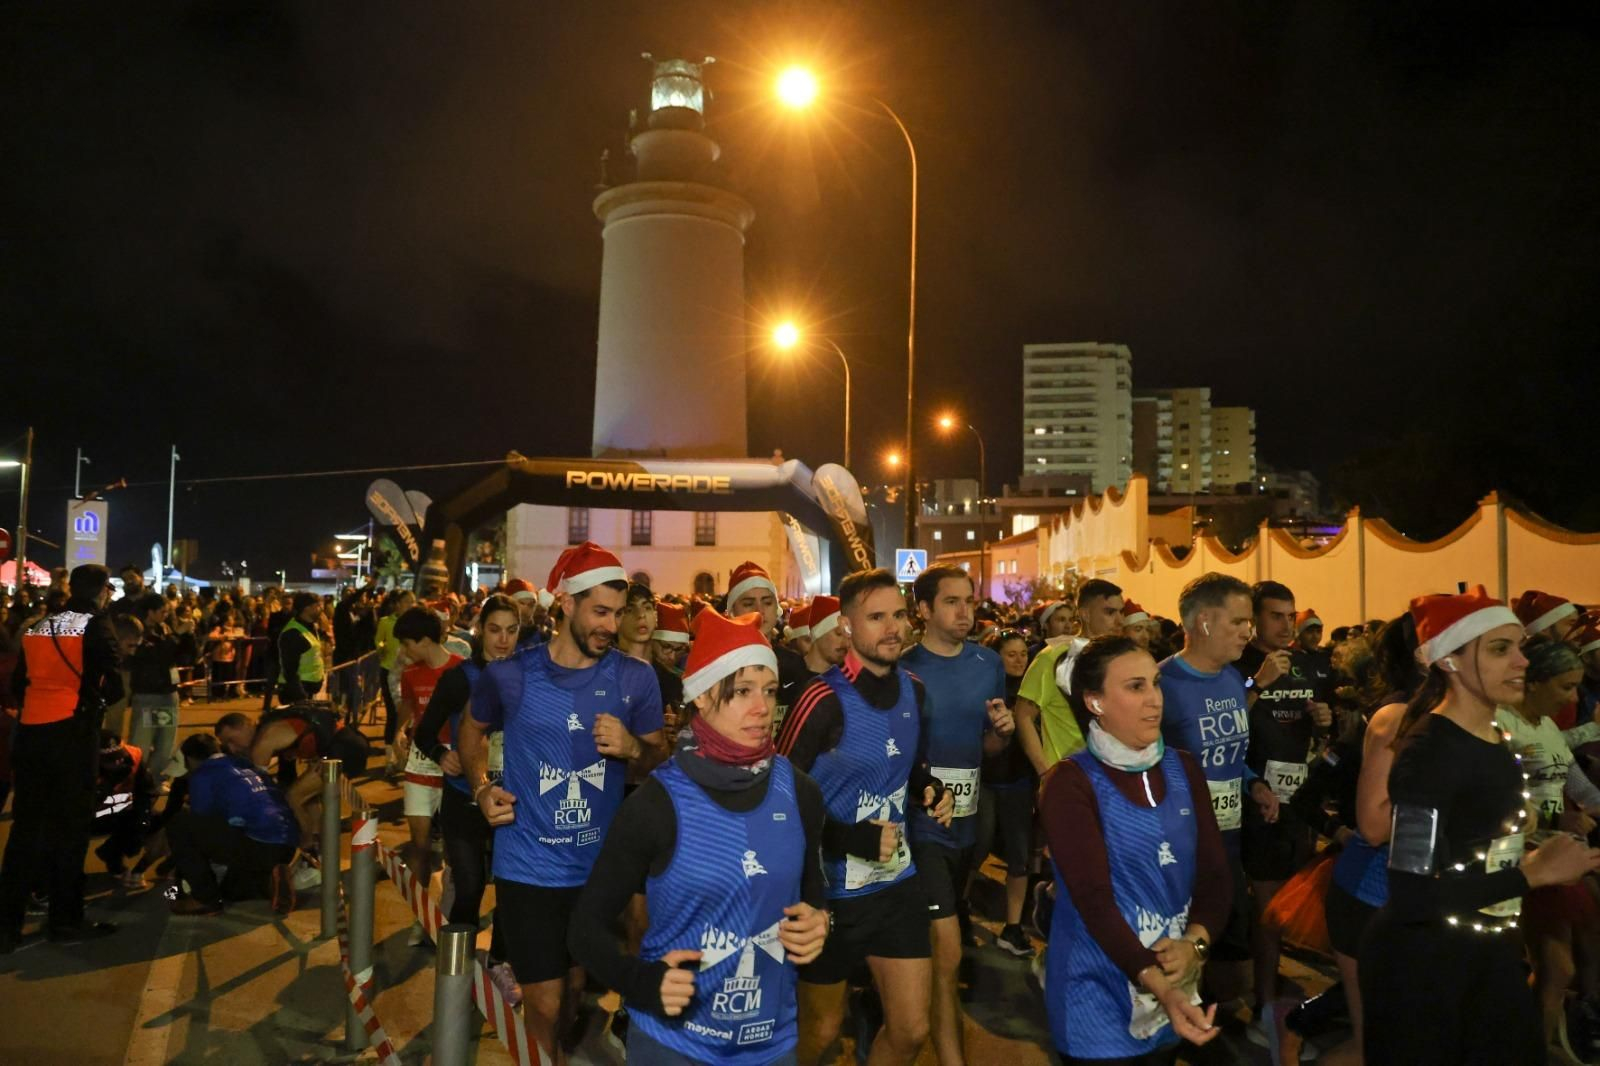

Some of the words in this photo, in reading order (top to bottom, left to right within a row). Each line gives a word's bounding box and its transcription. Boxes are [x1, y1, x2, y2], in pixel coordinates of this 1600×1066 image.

[566, 470, 732, 494] POWERADE
[1205, 697, 1237, 713] Remo
[1199, 708, 1249, 741] RCM
[554, 808, 592, 825] RCM
[538, 835, 573, 846] mayoral
[712, 988, 762, 1013] RCM
[684, 1020, 734, 1040] mayoral
